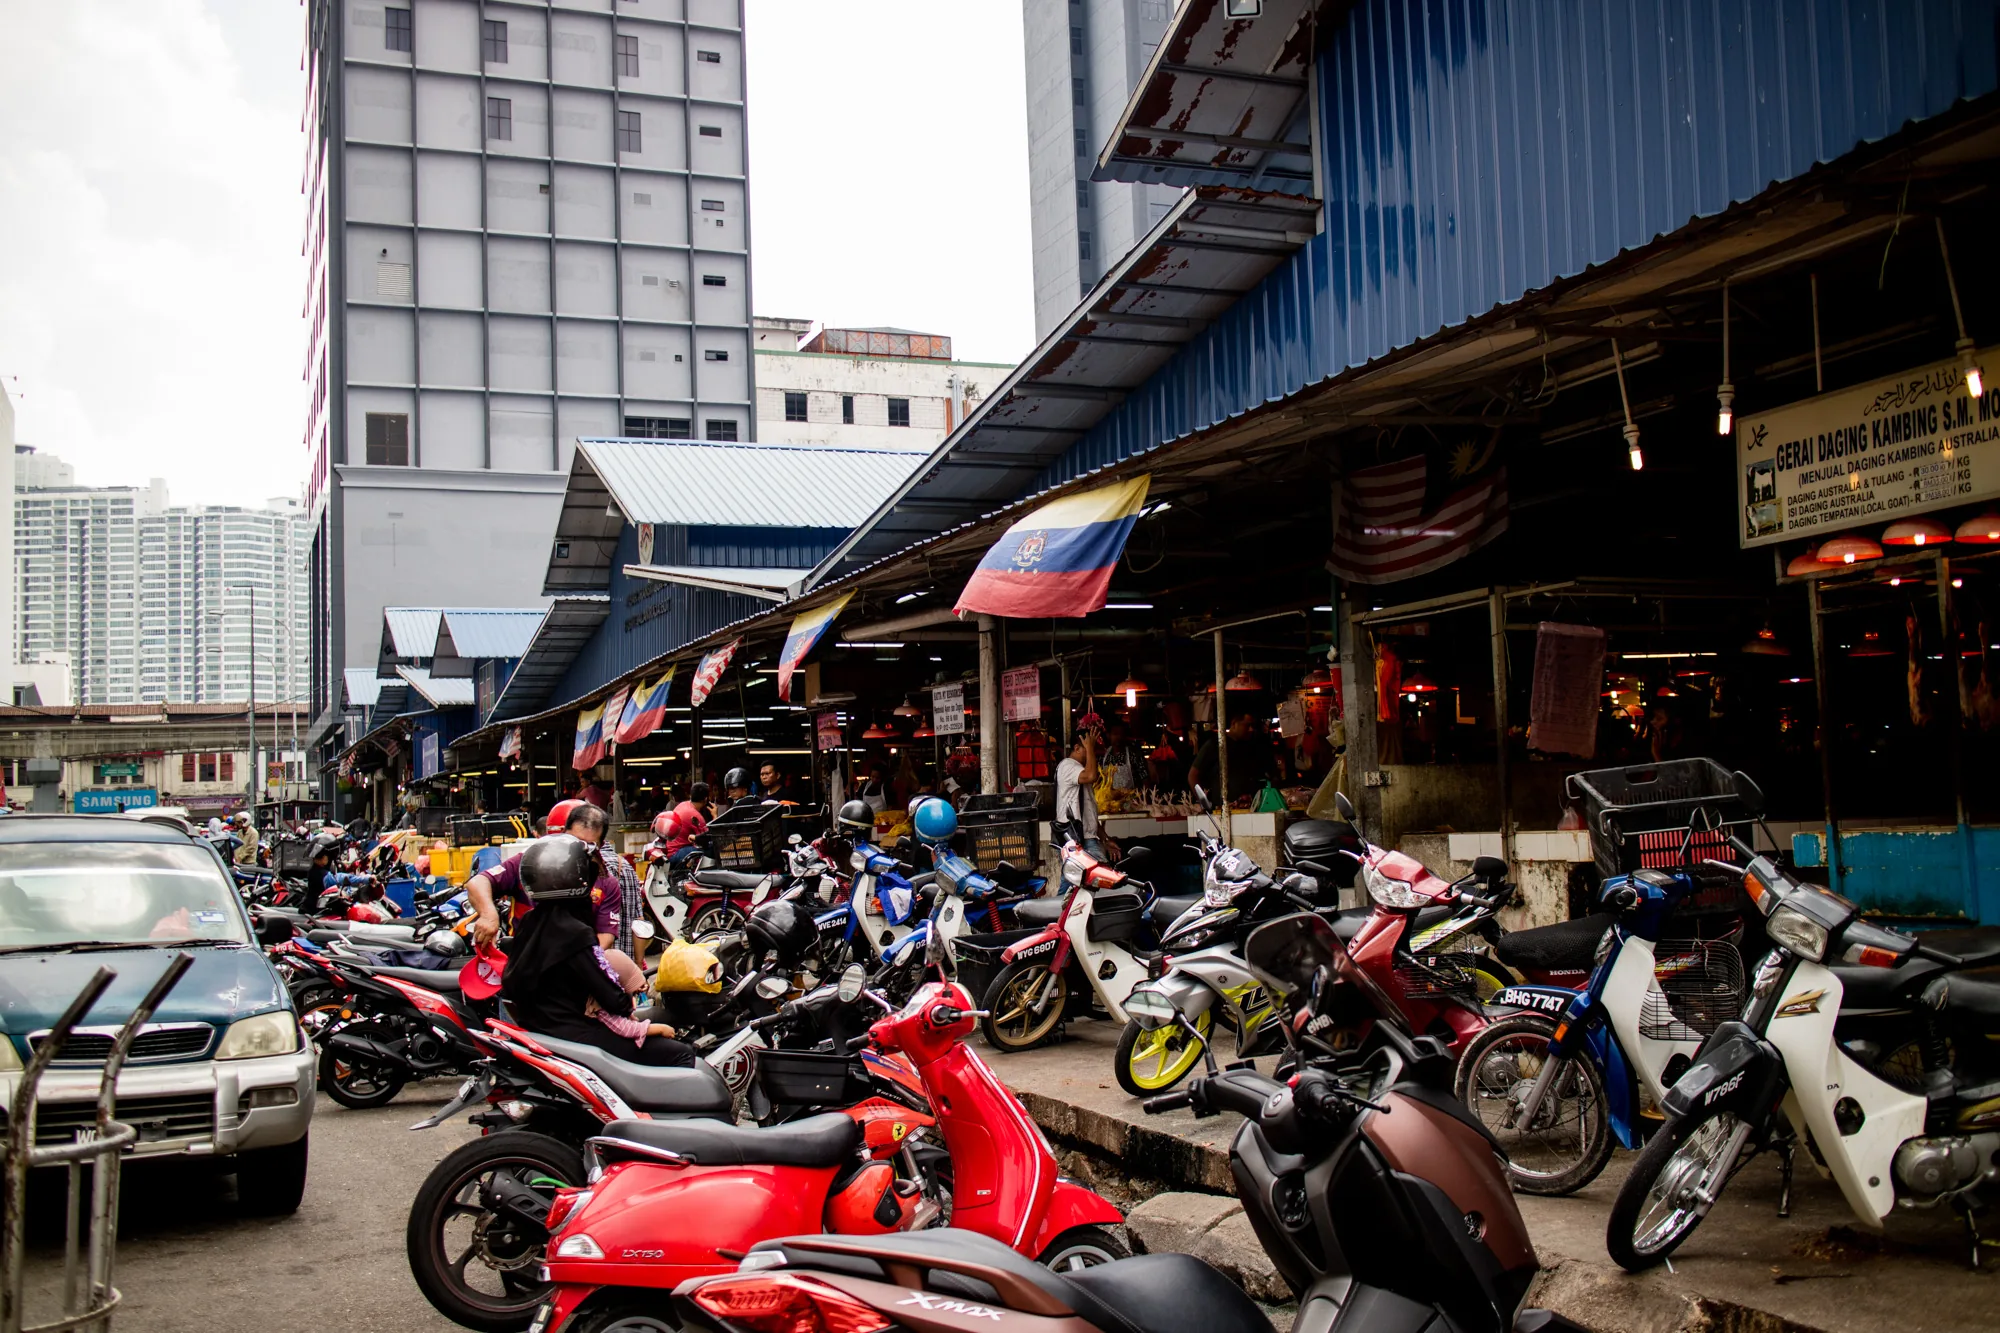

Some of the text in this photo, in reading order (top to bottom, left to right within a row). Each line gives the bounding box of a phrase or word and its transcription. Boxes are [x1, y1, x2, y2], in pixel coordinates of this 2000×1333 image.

[1777, 437, 1813, 472] GERAI
[1819, 423, 1867, 462] DAGING
[1872, 404, 1937, 449] KAMBING
[1943, 397, 1973, 431] S.M.
[1787, 491, 1816, 506] DAGING
[1818, 480, 1861, 498] AUSTRALIA
[1864, 479, 1869, 488] &
[1871, 471, 1904, 487] TULANG
[1957, 455, 1970, 468] KG
[1798, 464, 1845, 488] (MENJUAL
[1848, 454, 1886, 474] DAGING
[1887, 442, 1936, 465] KAMBING
[1788, 507, 1797, 518] ISI
[1799, 500, 1828, 515] DAGING
[1830, 490, 1875, 509] AUSTRALIA
[1957, 469, 1970, 480] KG
[1788, 515, 1818, 529] DAGING
[1820, 506, 1859, 523] TEMPATAN
[1959, 482, 1972, 494] KG
[81, 795, 151, 808] SAMSUNG
[818, 917, 847, 931] WVE 2414
[1017, 948, 1033, 960] WYG
[1549, 968, 1586, 976] HONDA
[1531, 993, 1564, 1012] 7747
[1704, 1070, 1745, 1106] W786F
[896, 1291, 1006, 1321] XMAX
